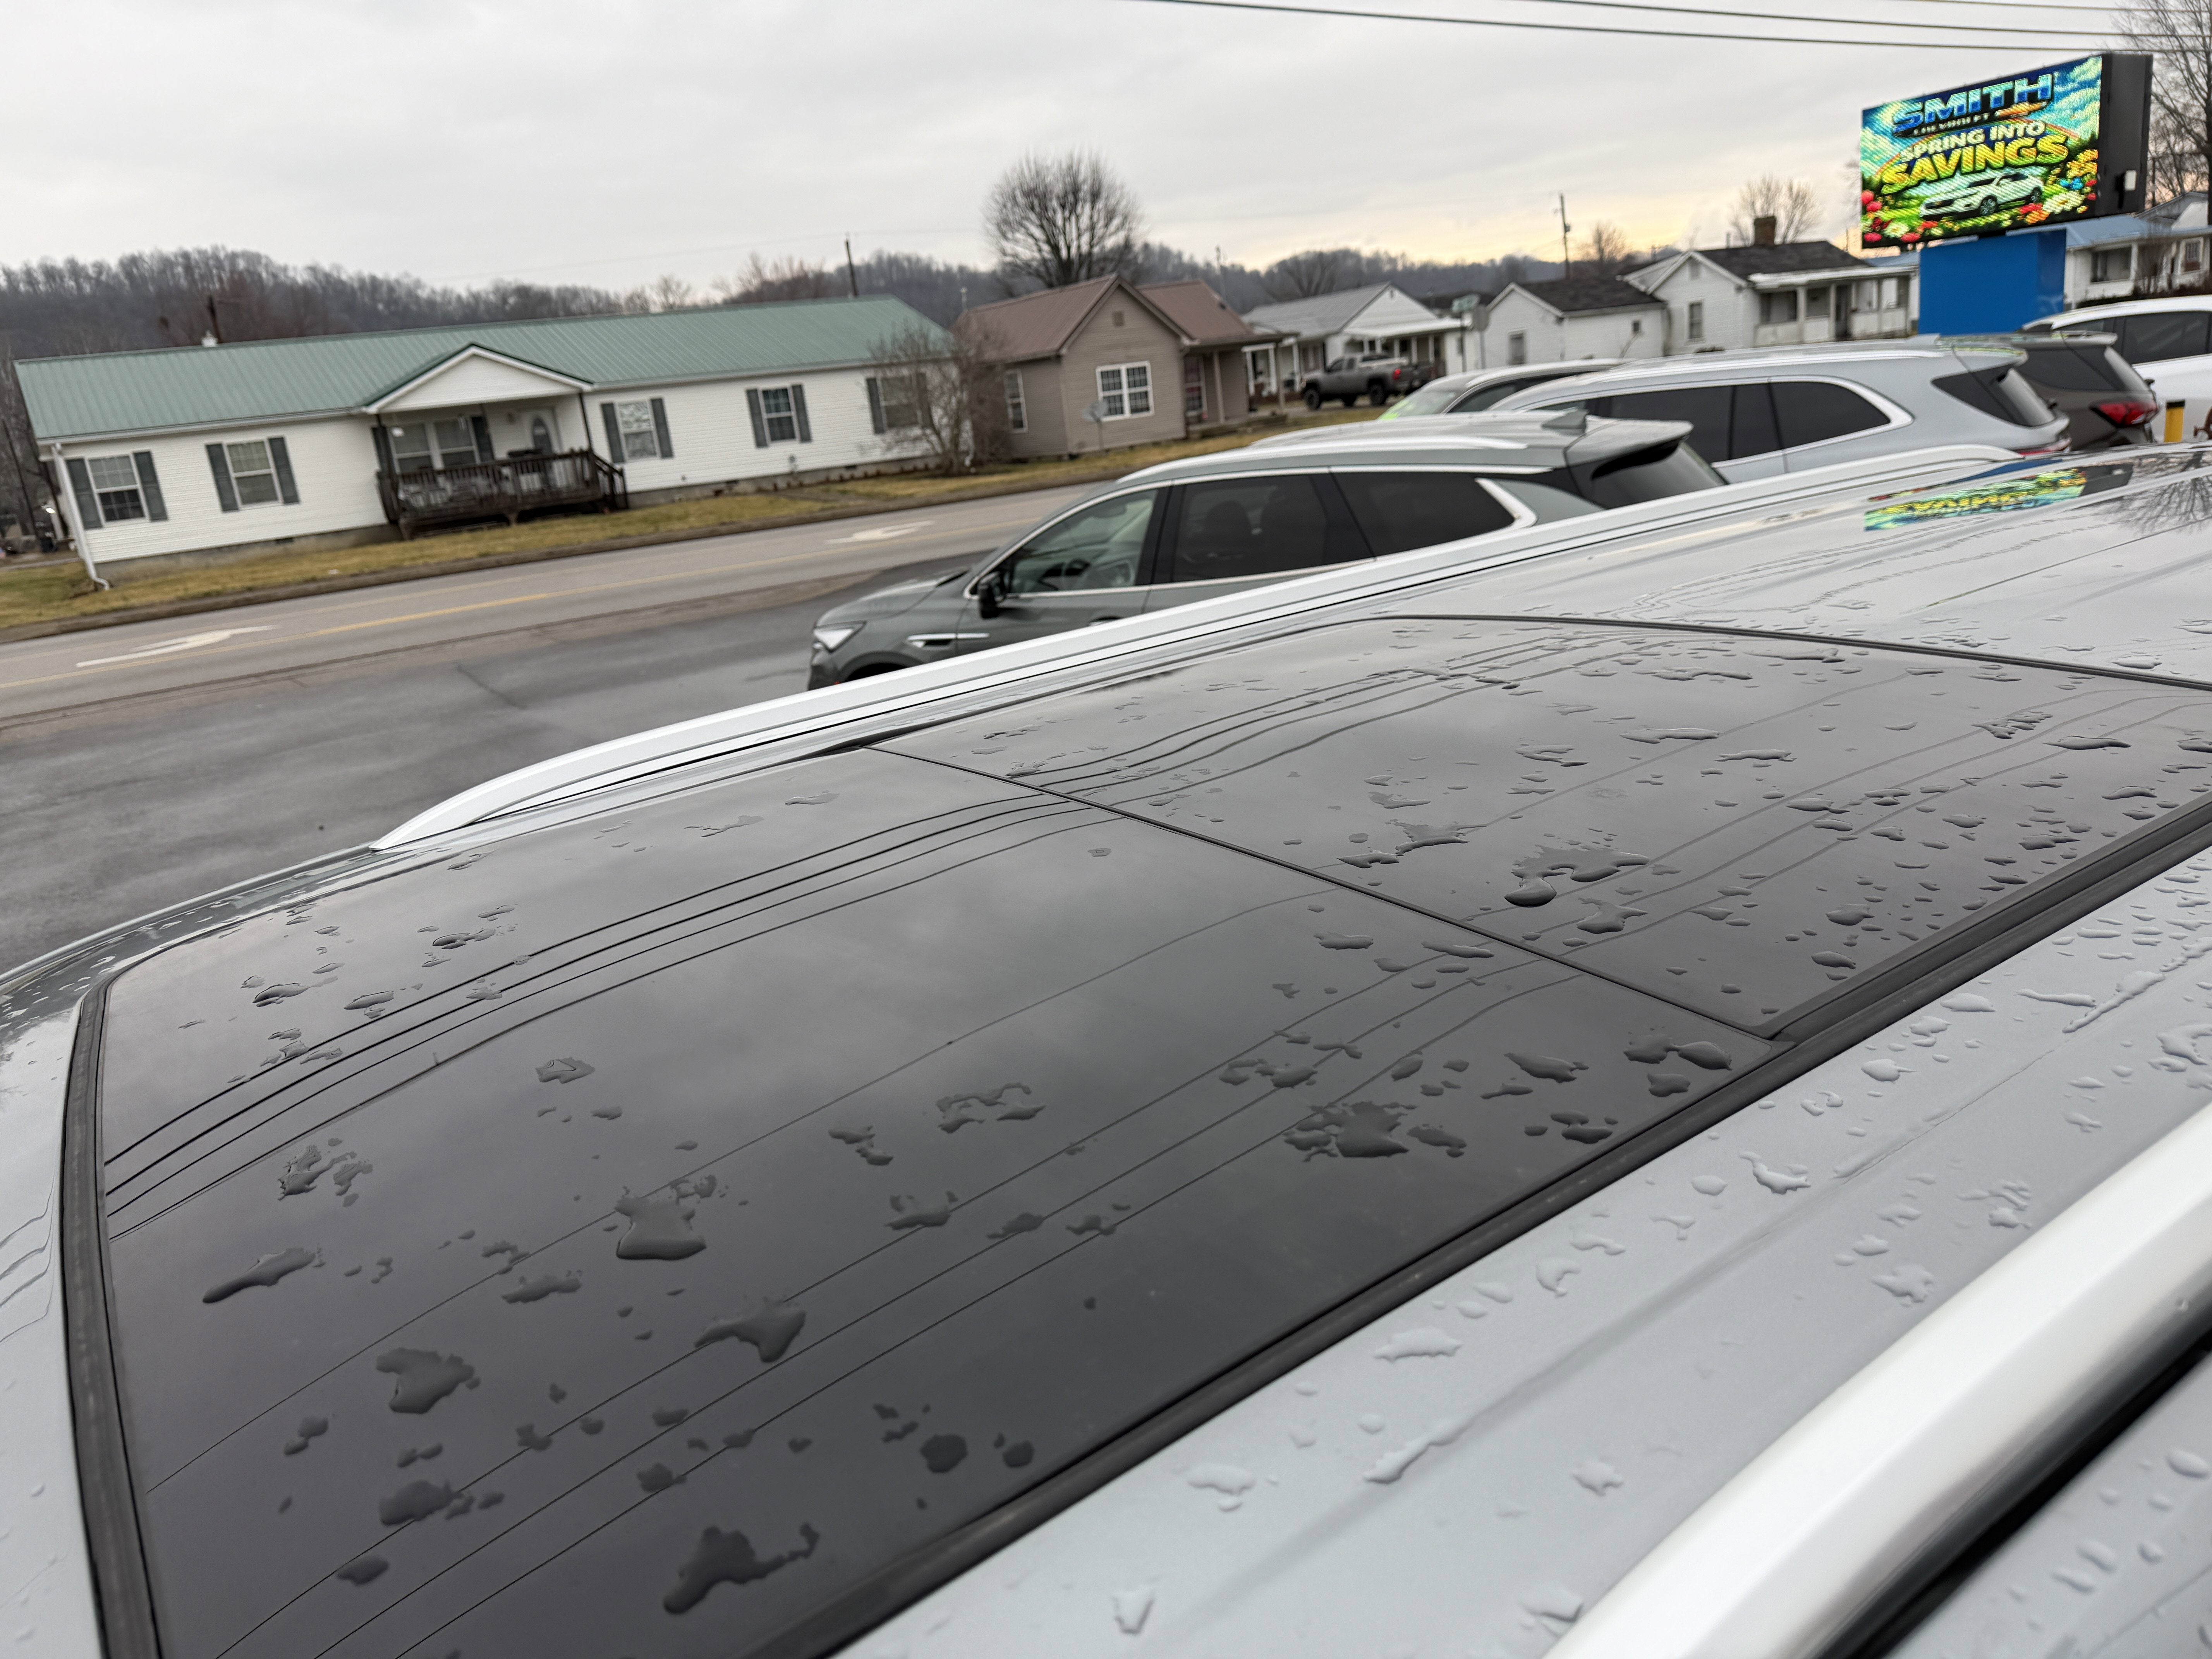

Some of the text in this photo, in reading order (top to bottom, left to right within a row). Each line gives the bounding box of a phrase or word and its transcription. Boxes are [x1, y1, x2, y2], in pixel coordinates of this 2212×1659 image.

[1893, 74, 2052, 132] SMITH
[1881, 135, 2068, 194] SAVINGS
[1899, 129, 1985, 162] SPRING
[1990, 121, 2046, 141] INTO
